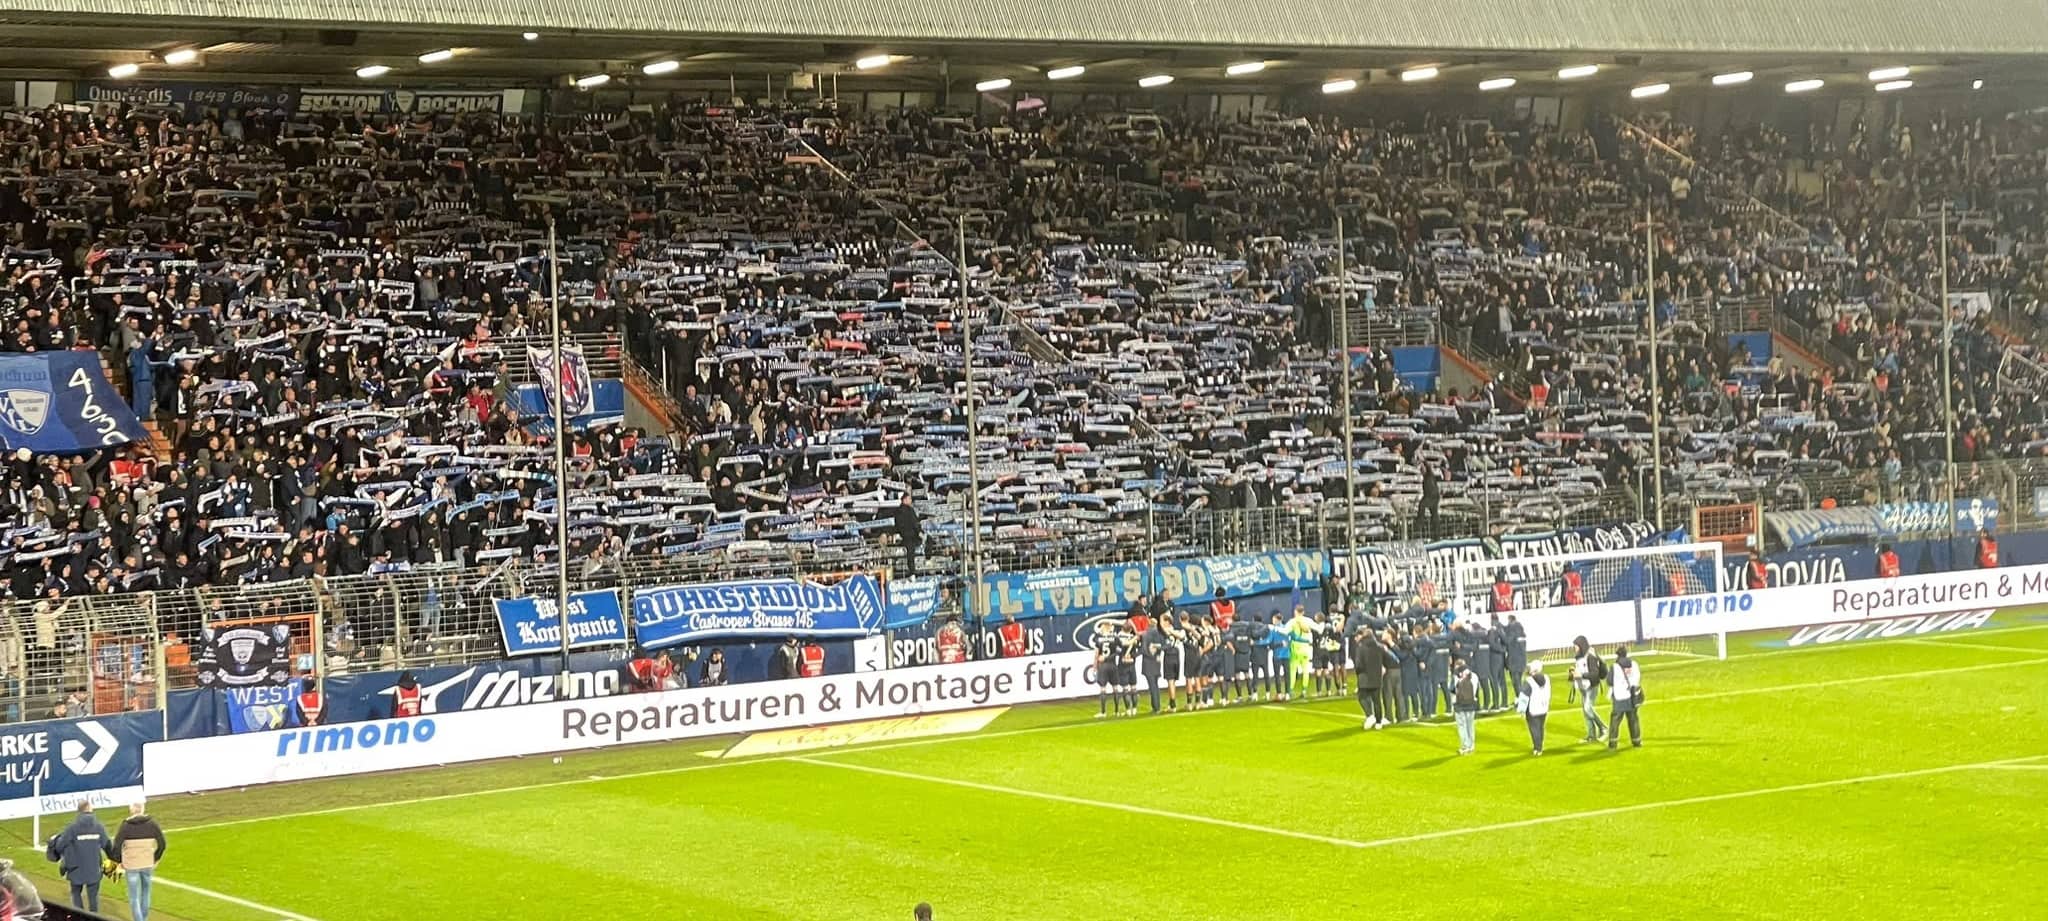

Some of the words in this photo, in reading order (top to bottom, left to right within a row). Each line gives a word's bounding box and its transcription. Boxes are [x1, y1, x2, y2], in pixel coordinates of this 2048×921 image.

[301, 95, 381, 112] SEKTION
[418, 95, 500, 113] BOCHUM
[637, 584, 848, 625] RUHRSTADION
[1656, 593, 1753, 618] rimono
[1833, 580, 1988, 615] Reparaturen
[1998, 574, 2012, 597] &
[232, 683, 298, 705] WEST
[562, 692, 805, 742] Reparaturen
[818, 683, 841, 712] &
[855, 672, 1013, 709] Montage
[1023, 661, 1072, 691] für
[0, 731, 49, 757] RKE
[276, 718, 436, 757] rimono
